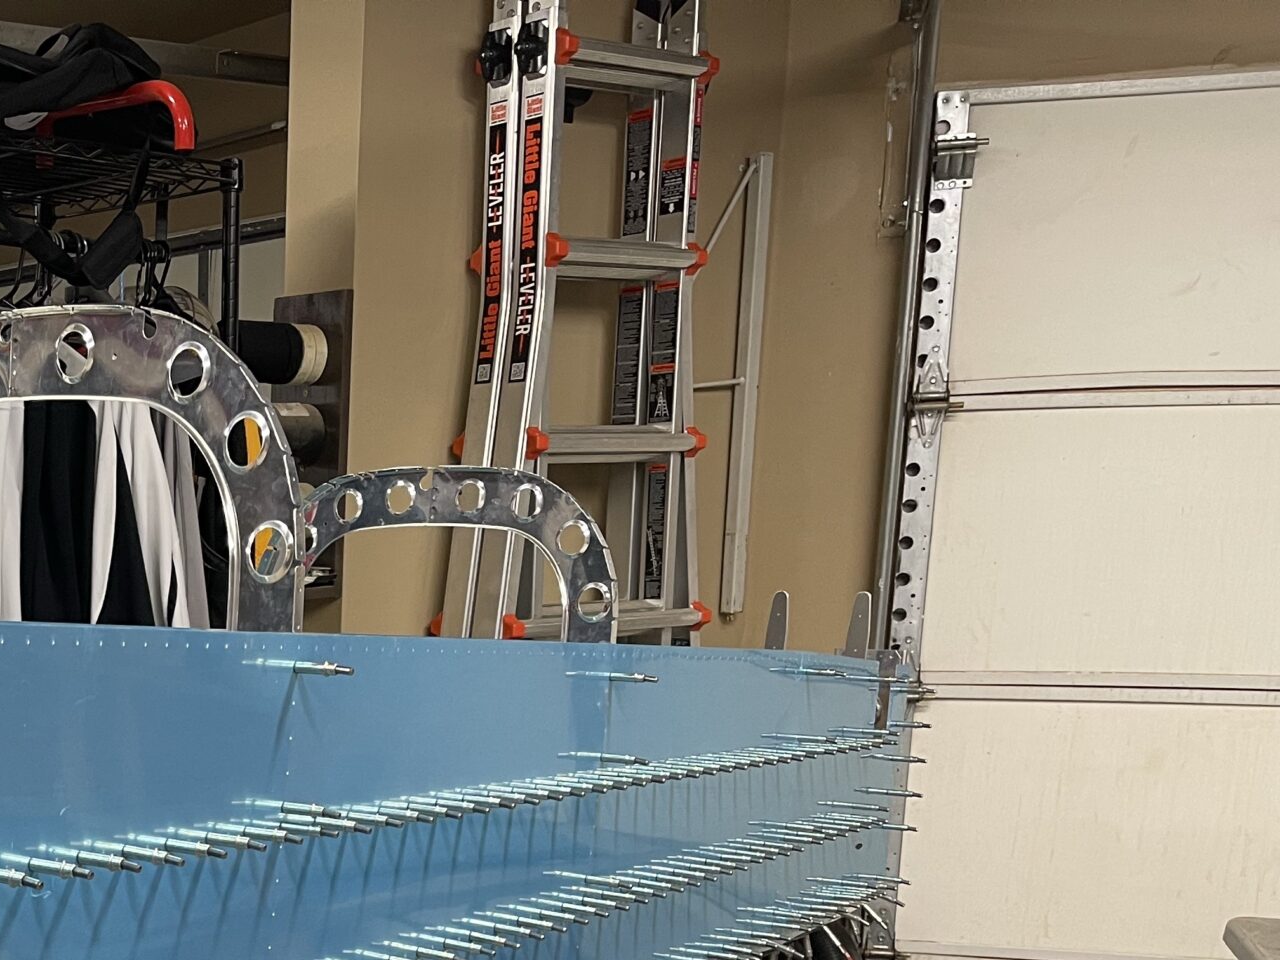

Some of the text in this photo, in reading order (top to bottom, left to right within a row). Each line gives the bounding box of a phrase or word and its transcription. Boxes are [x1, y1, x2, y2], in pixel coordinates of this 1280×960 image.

[524, 123, 541, 184] Little
[521, 190, 538, 250] Giant
[479, 151, 505, 359] Little Giant LEVELER
[515, 262, 536, 336] LEVELER
